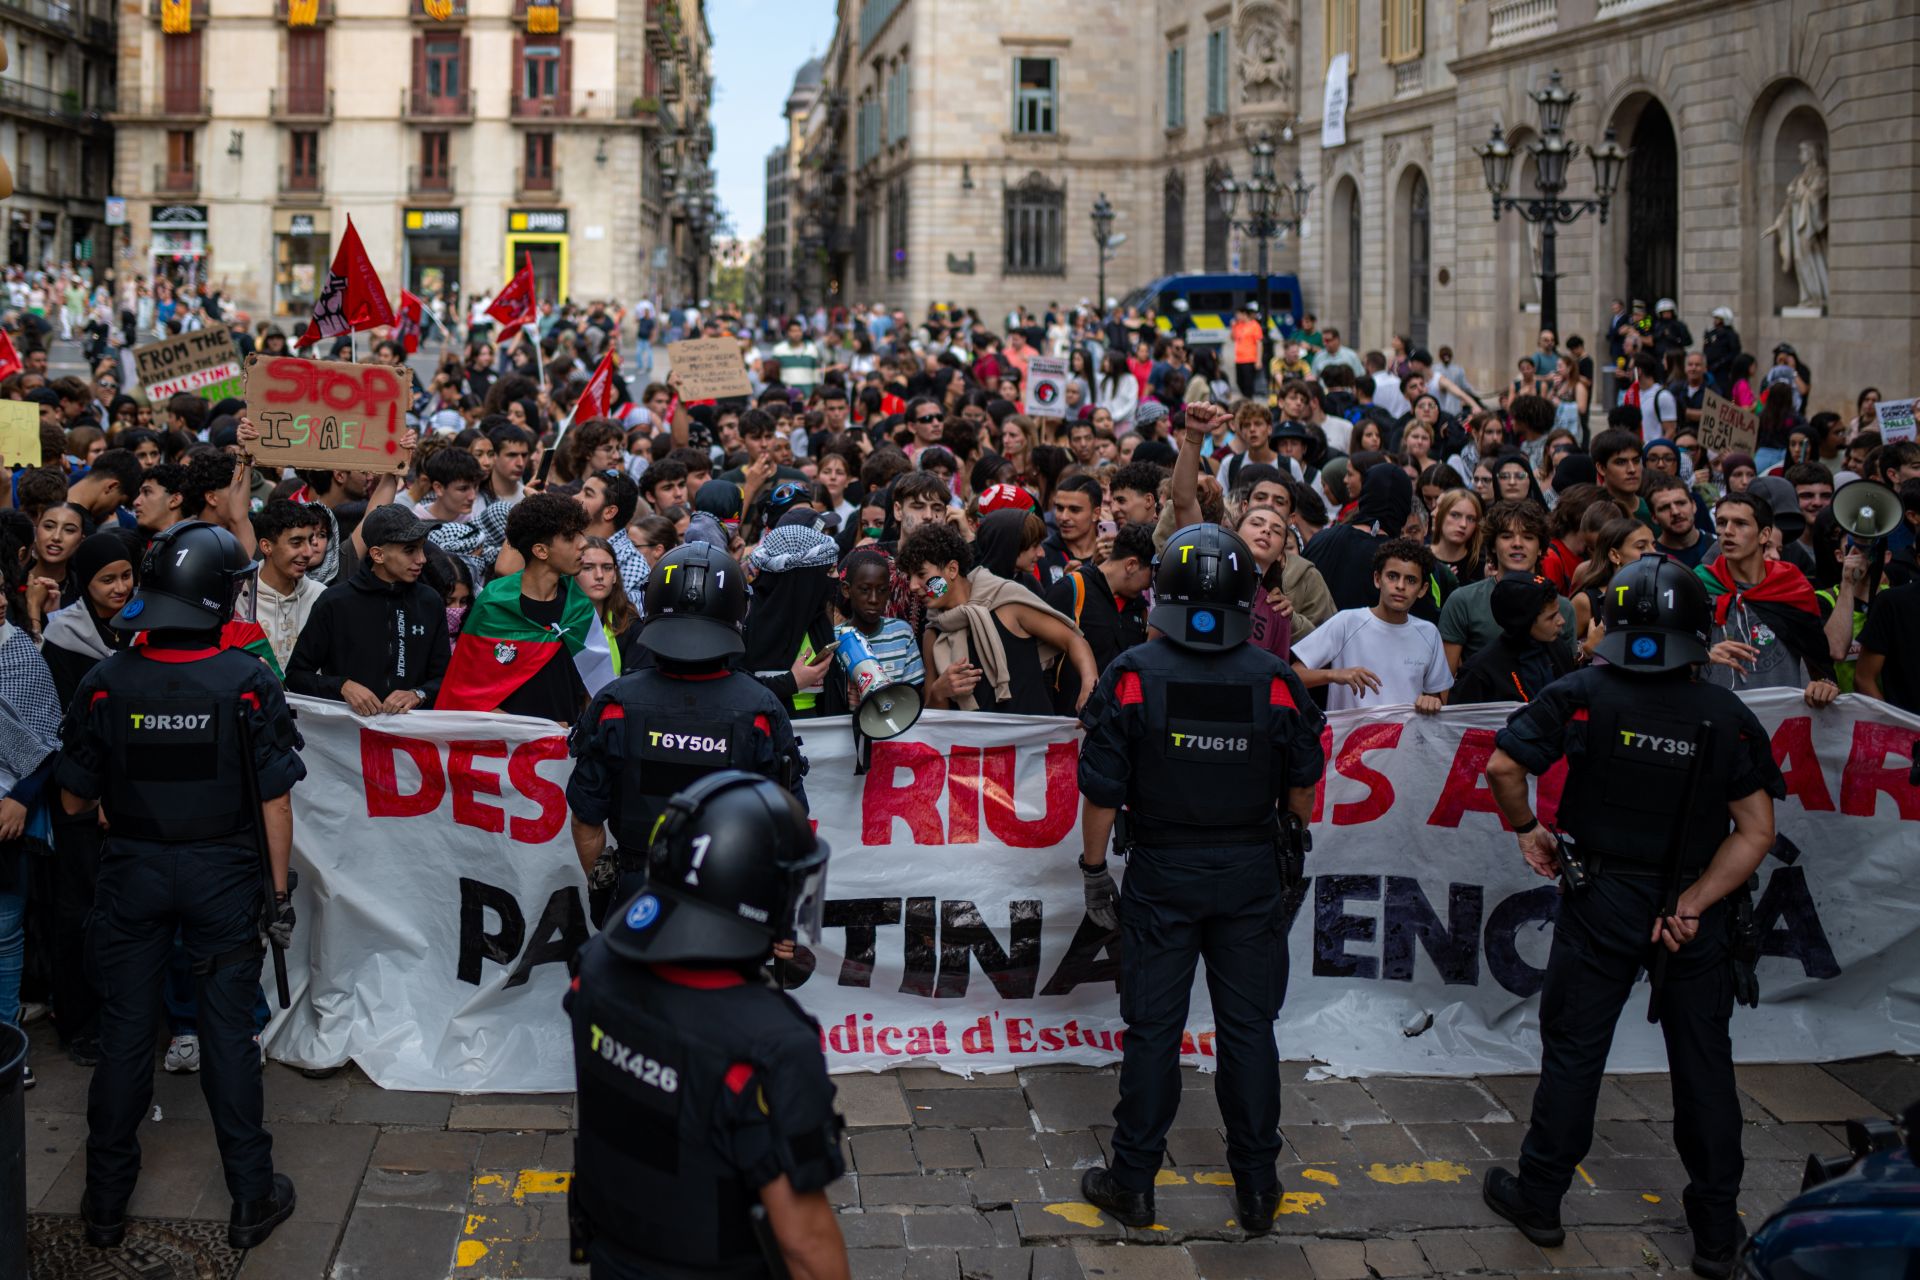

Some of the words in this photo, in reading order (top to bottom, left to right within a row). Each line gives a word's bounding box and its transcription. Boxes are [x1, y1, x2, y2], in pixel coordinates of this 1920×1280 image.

[138, 341, 189, 371] FROM
[191, 329, 229, 351] THE
[264, 357, 400, 417] STOP
[175, 548, 189, 567] 1
[1179, 545, 1194, 564] T
[1228, 552, 1238, 571] 1
[663, 564, 678, 584] T
[716, 570, 725, 589] 1
[1615, 585, 1630, 607] T
[1663, 589, 1674, 609] 1
[396, 638, 406, 677] ARMOUR
[130, 714, 211, 730] T9R307
[648, 731, 727, 753] T6Y504
[1171, 732, 1248, 752] T7U618
[861, 738, 1080, 849] RIU
[1770, 716, 1920, 822] AR
[690, 833, 712, 869] 1
[456, 876, 1121, 999] PATINA
[589, 1023, 679, 1094] T9X426
